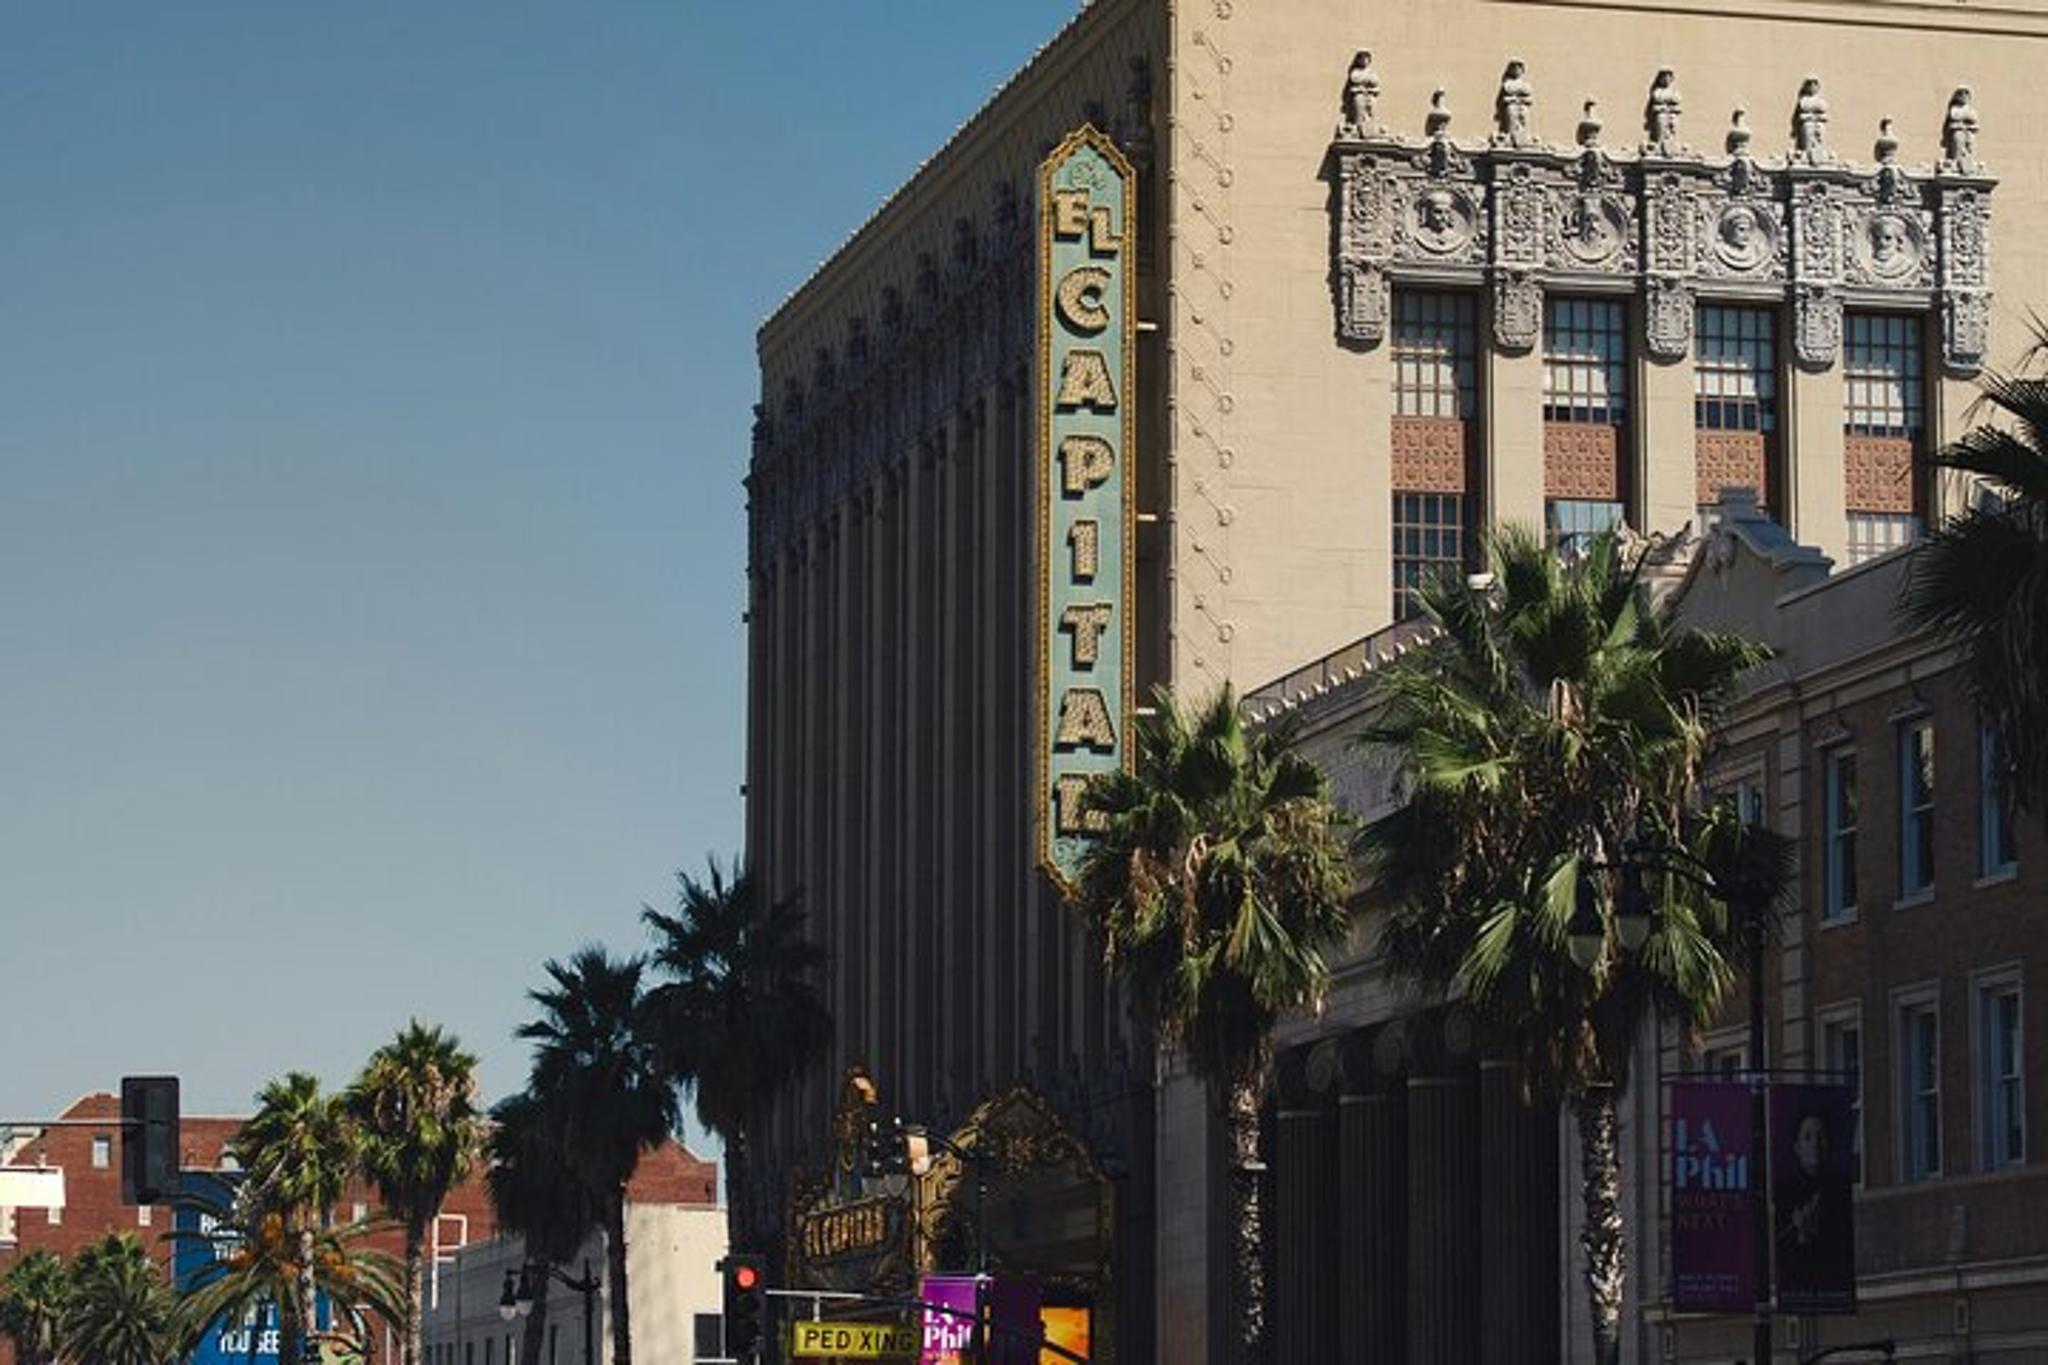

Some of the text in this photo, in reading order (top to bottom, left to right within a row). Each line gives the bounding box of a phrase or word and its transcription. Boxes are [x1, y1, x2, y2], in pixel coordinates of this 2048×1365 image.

[1054, 187, 1123, 258] EL
[1675, 1117, 1721, 1152] LA
[1675, 1152, 1748, 1189] Phil
[803, 1329, 914, 1352] PED XING
[923, 1323, 972, 1349] Phil
